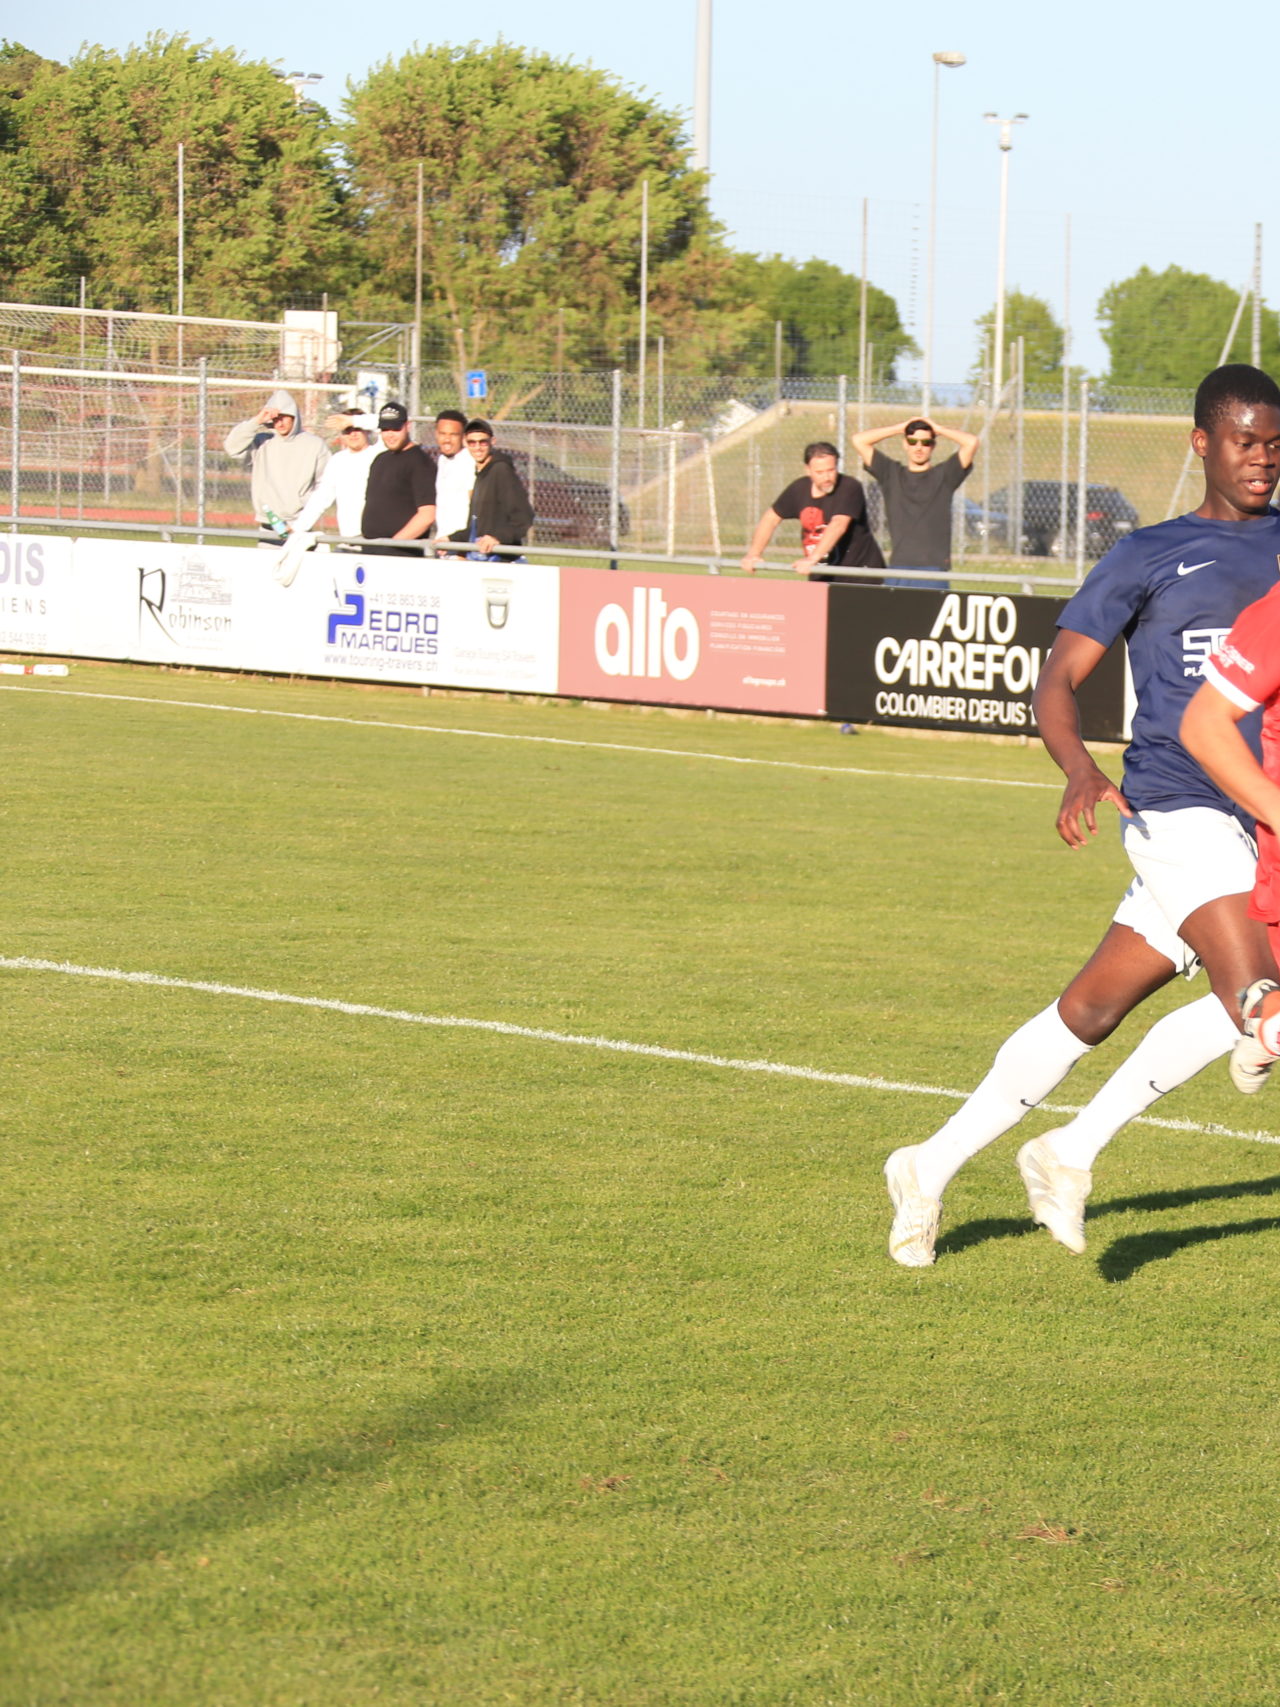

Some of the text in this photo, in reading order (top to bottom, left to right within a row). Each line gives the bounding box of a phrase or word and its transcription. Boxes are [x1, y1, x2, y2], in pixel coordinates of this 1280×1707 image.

[341, 632, 438, 655] MARQUES
[594, 586, 700, 681] alto
[929, 593, 1017, 644] AUTO
[875, 636, 1051, 694] CARREFOU
[875, 691, 967, 721] COLOMBIER
[968, 698, 1026, 726] DEPUIS
